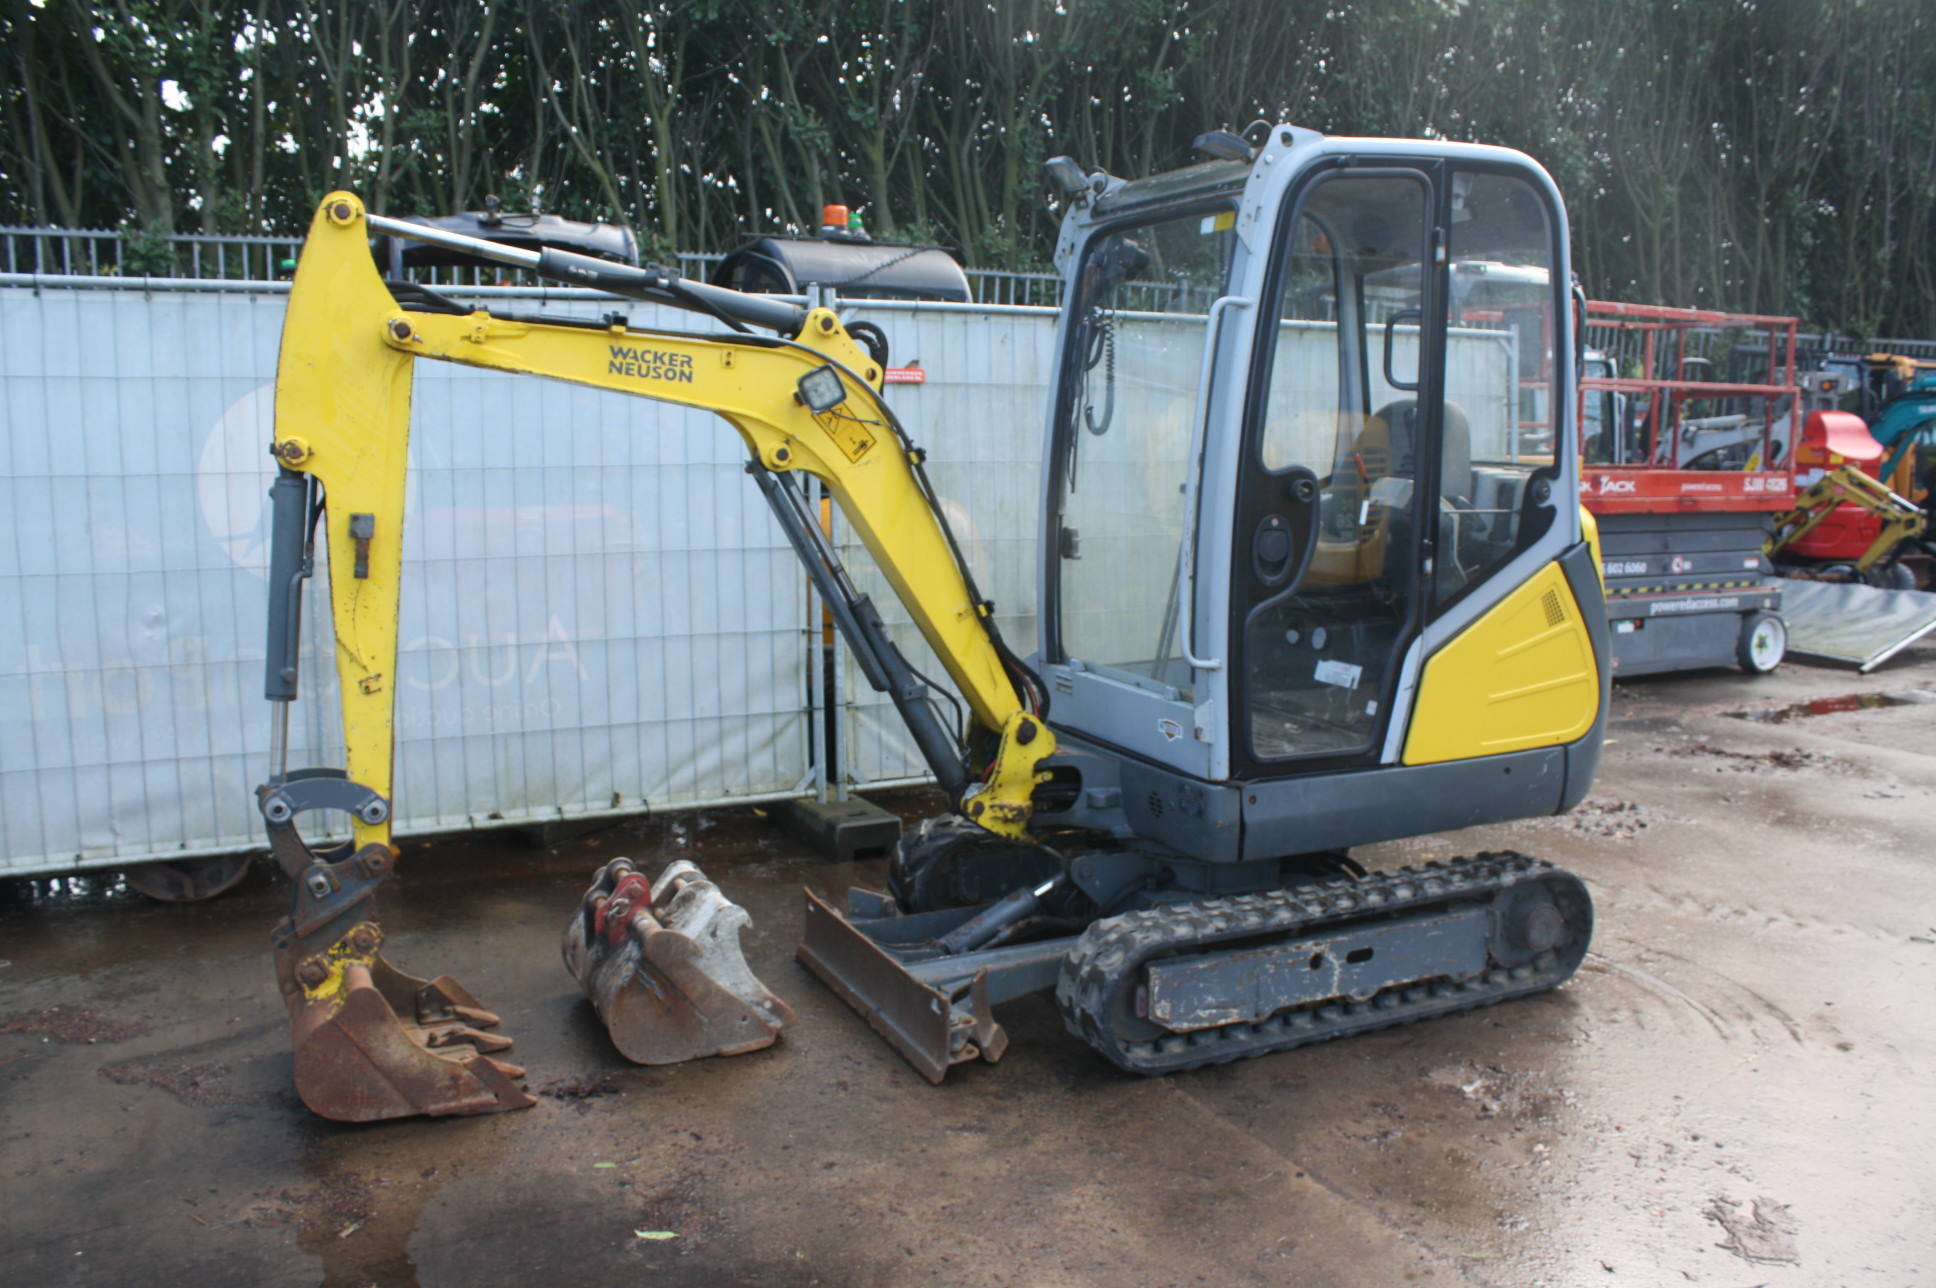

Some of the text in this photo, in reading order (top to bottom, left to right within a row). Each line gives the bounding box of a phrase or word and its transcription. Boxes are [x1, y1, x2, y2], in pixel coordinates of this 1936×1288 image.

[608, 345, 693, 368] WACKER
[608, 360, 693, 383] NEUSON
[1650, 597, 1739, 616] poweredaccess.com
